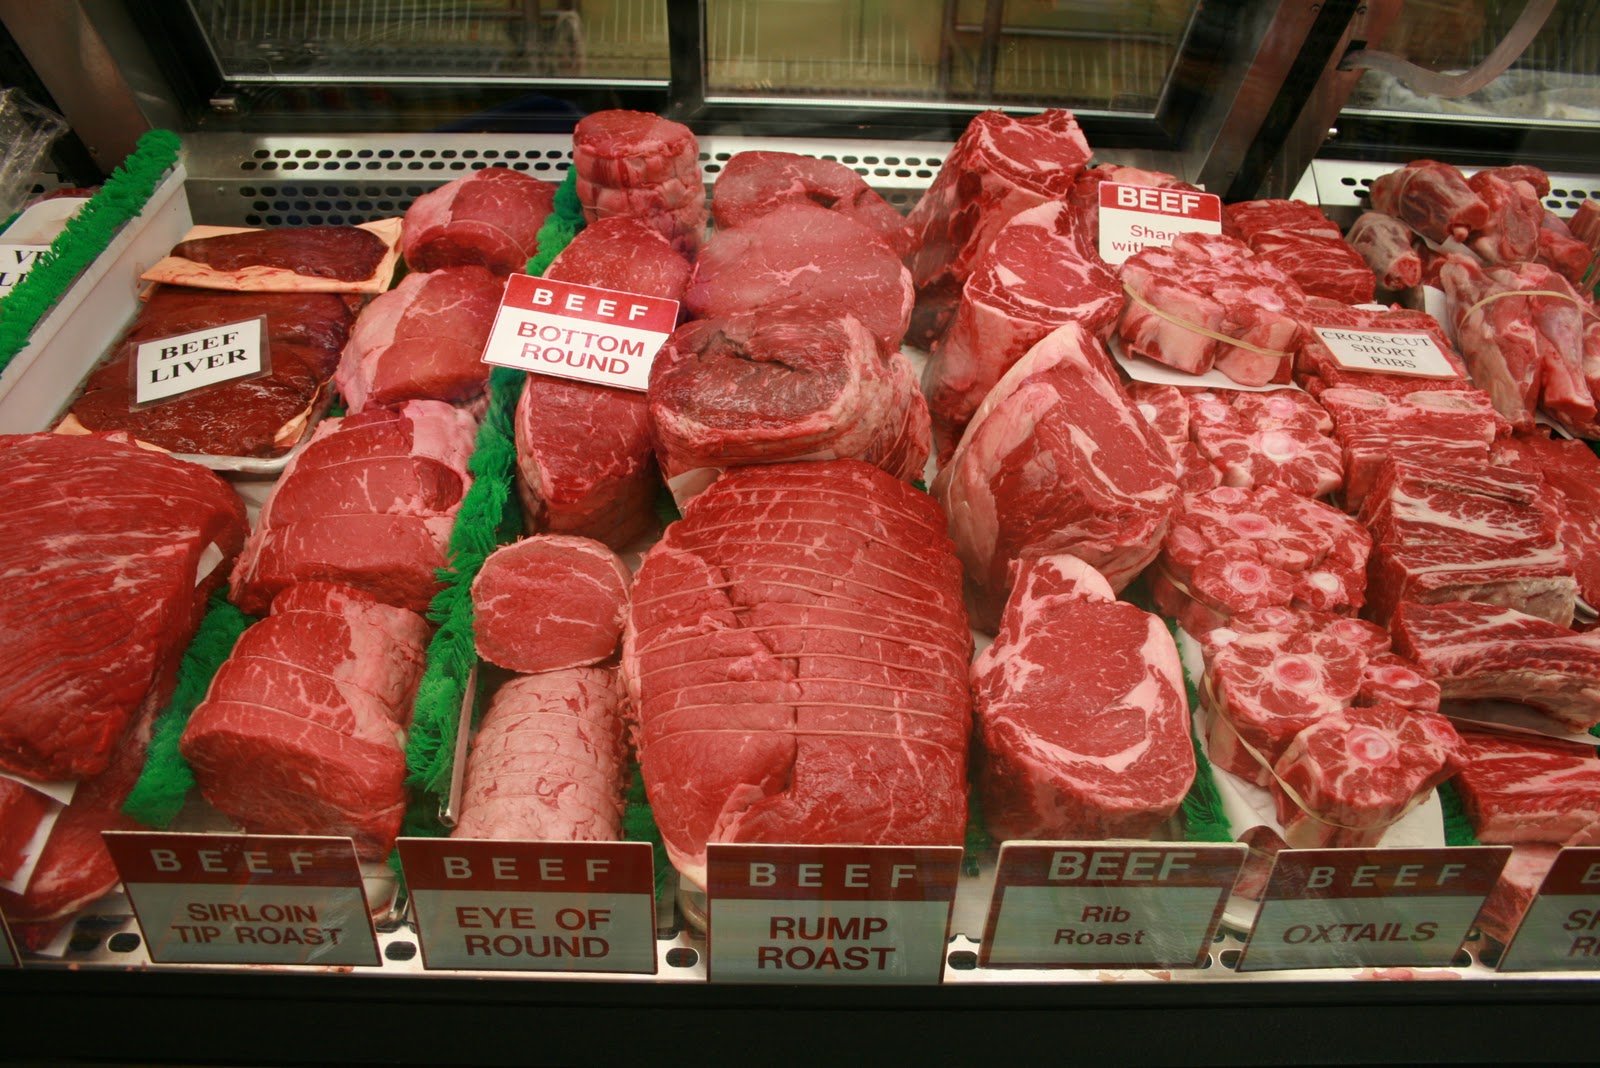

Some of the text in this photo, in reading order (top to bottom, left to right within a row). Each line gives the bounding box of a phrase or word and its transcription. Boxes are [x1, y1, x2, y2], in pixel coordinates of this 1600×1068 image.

[1117, 186, 1200, 214] BEEF
[1130, 224, 1180, 241] Shan
[532, 287, 648, 321] BEEF
[160, 331, 239, 361] BEEF
[517, 320, 645, 357] BOTTOM
[1321, 331, 1430, 347] CROSS-CUT
[1351, 343, 1415, 357] SHORT
[149, 348, 248, 383] LIVER
[520, 342, 630, 375] ROUND
[1371, 356, 1417, 369] RIBS
[149, 848, 314, 875] BEEF
[443, 856, 611, 882] BEEF
[1047, 851, 1197, 881] BEEF
[748, 862, 917, 888] BEEF
[1306, 864, 1467, 888] BEEF
[187, 903, 317, 925] SIRLOIN
[456, 906, 611, 931] EYE OF
[1080, 905, 1130, 923] Rib
[171, 925, 343, 946] TIP ROAST
[769, 916, 888, 941] RUMP
[1053, 928, 1147, 946] Roast
[1282, 922, 1439, 944] OXTAILS
[466, 934, 610, 958] ROUND
[757, 946, 896, 971] ROAST
